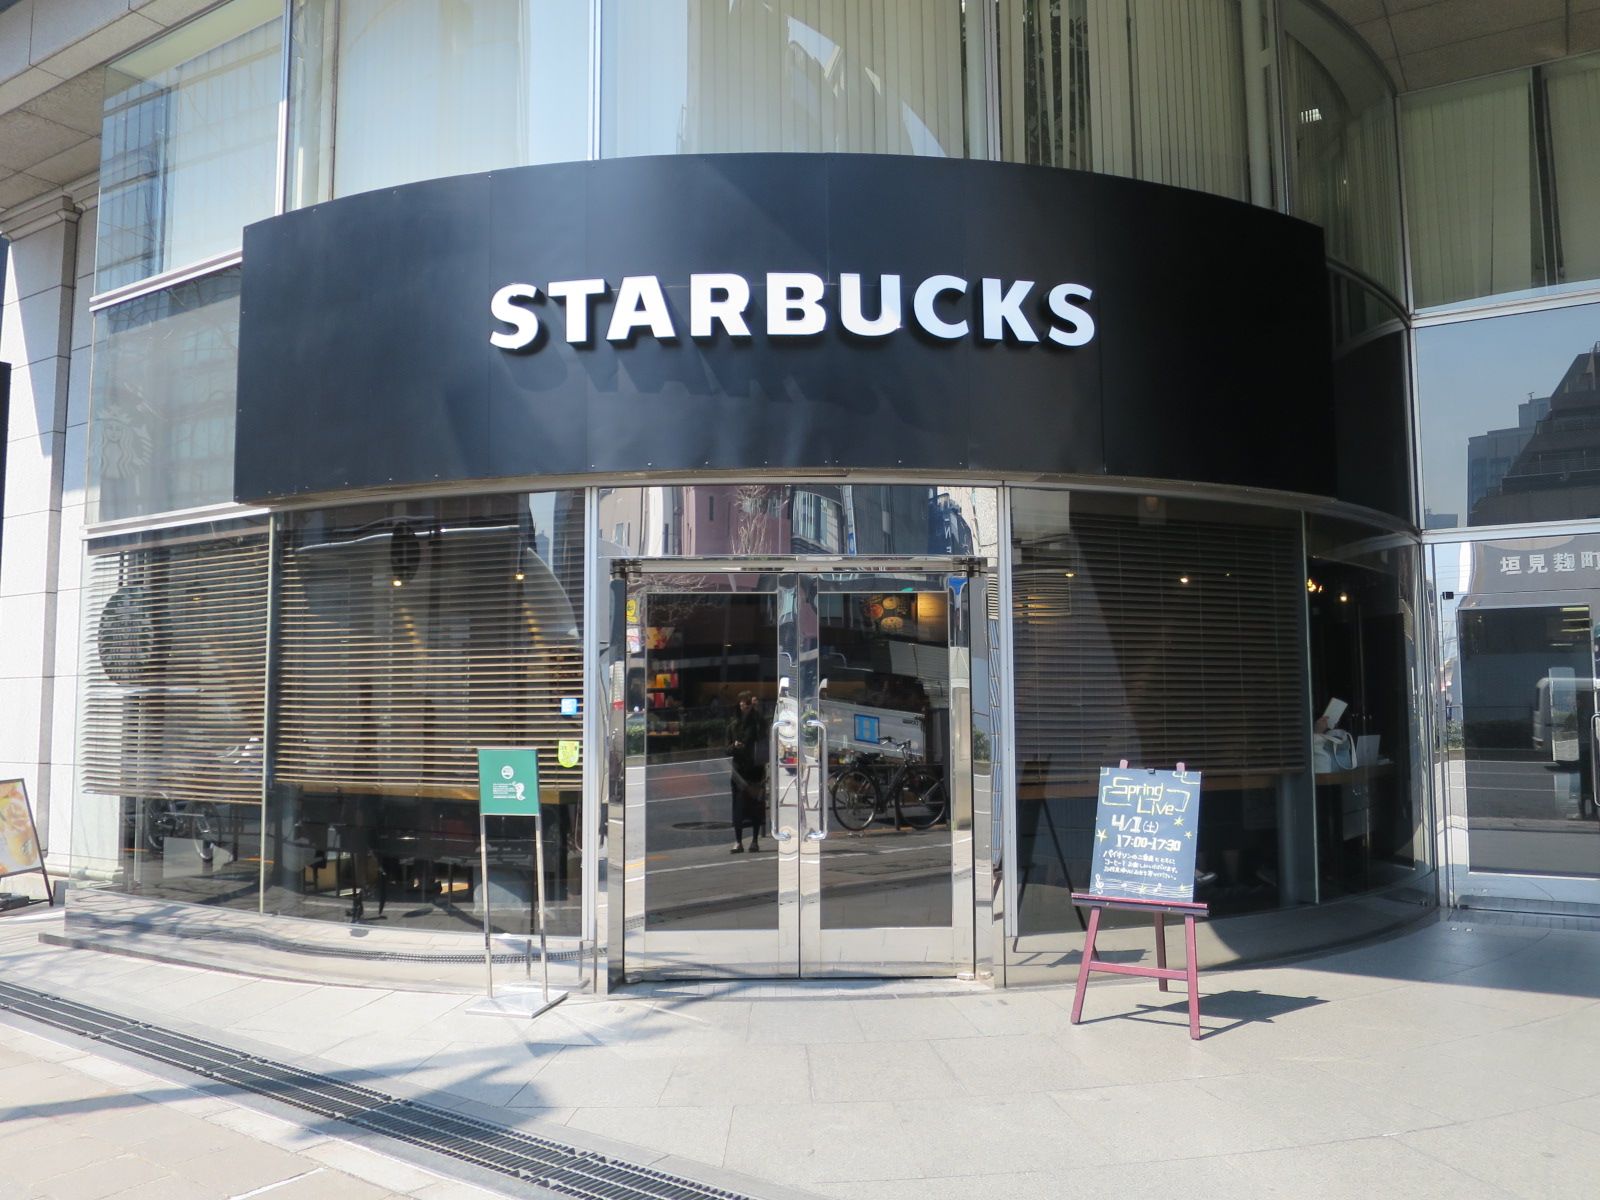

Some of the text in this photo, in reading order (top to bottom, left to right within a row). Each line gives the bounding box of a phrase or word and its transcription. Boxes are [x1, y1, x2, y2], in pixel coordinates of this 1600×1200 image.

[489, 271, 1096, 349] STARBUCKS
[1108, 776, 1164, 802] Spring
[1136, 796, 1175, 816] Live
